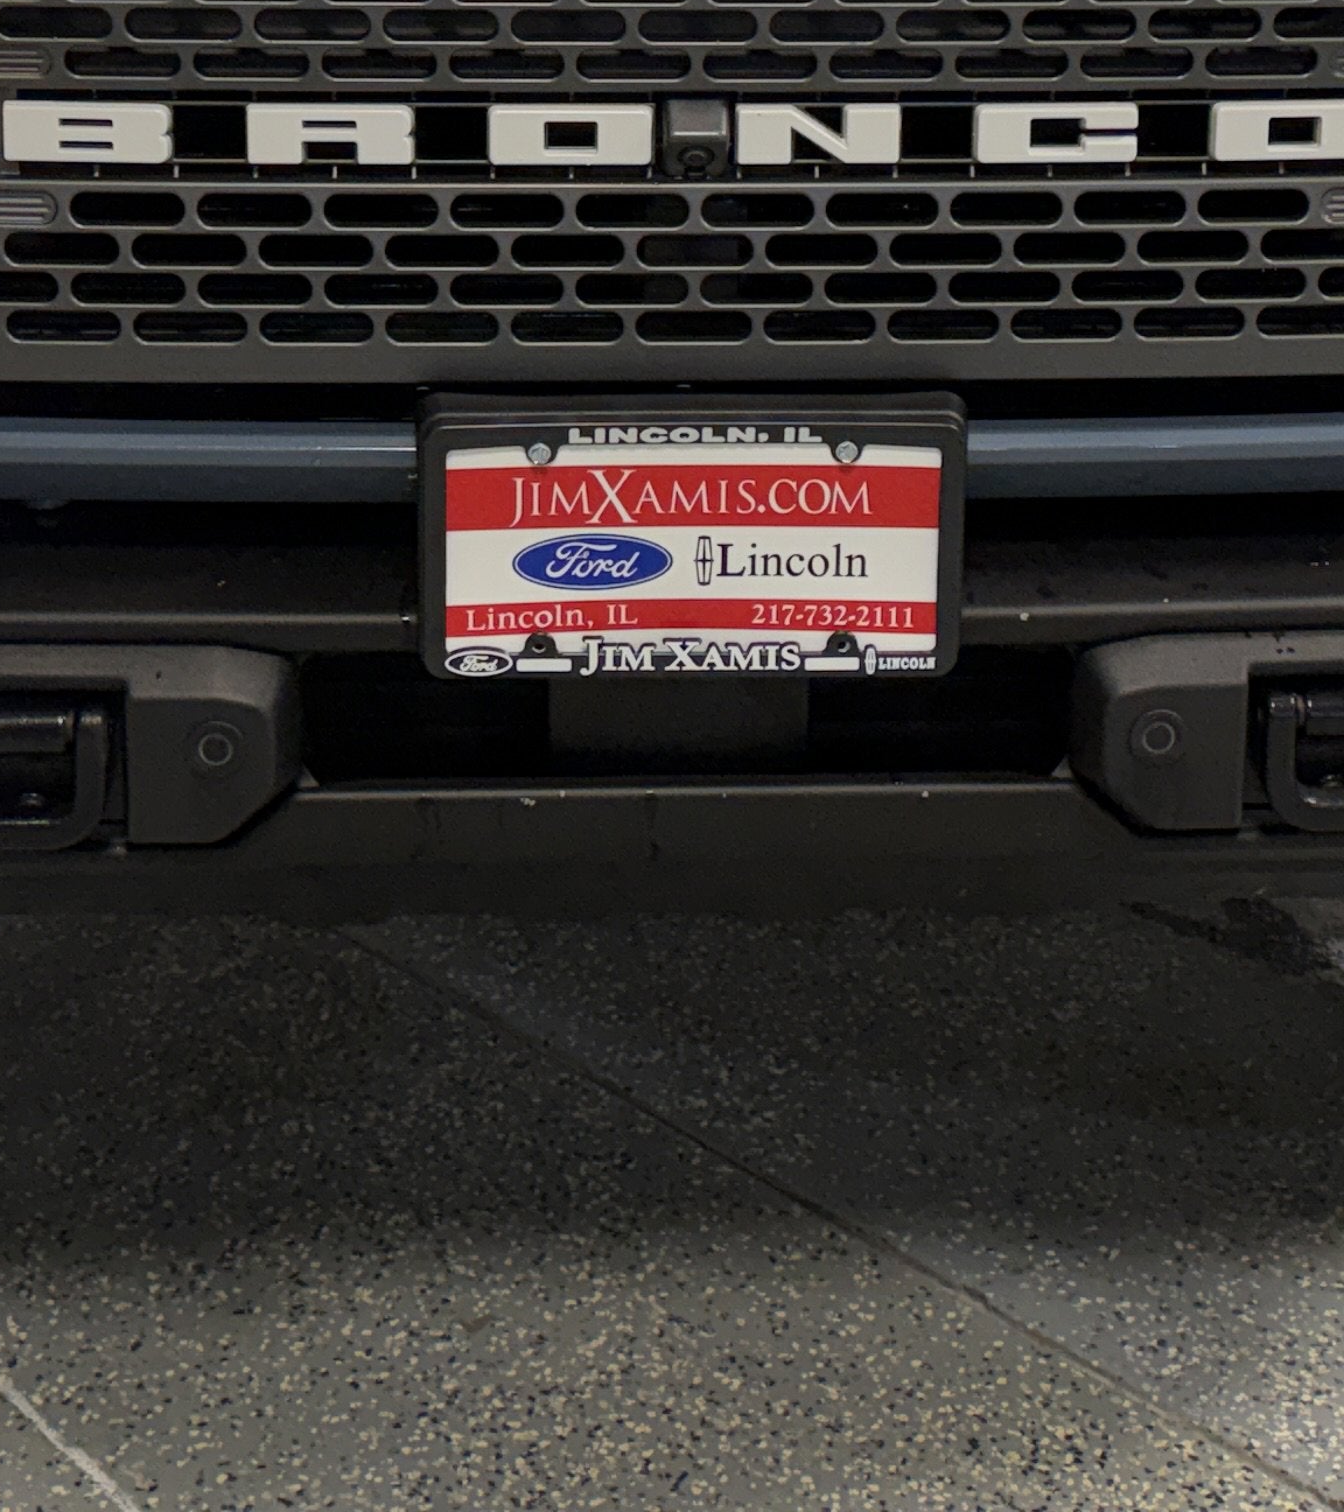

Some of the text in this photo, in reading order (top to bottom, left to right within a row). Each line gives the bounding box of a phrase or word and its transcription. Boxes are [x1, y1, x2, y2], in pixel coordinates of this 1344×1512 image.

[784, 426, 824, 444] IL
[509, 468, 872, 528] JIMXAMIS.COM
[545, 540, 868, 579] Ford Lincoln
[466, 604, 914, 631] Lincoln, IL 217-732-2111
[579, 637, 655, 676] JIM
[664, 638, 801, 673] XAMIS
[878, 657, 936, 672] LINCOLN
